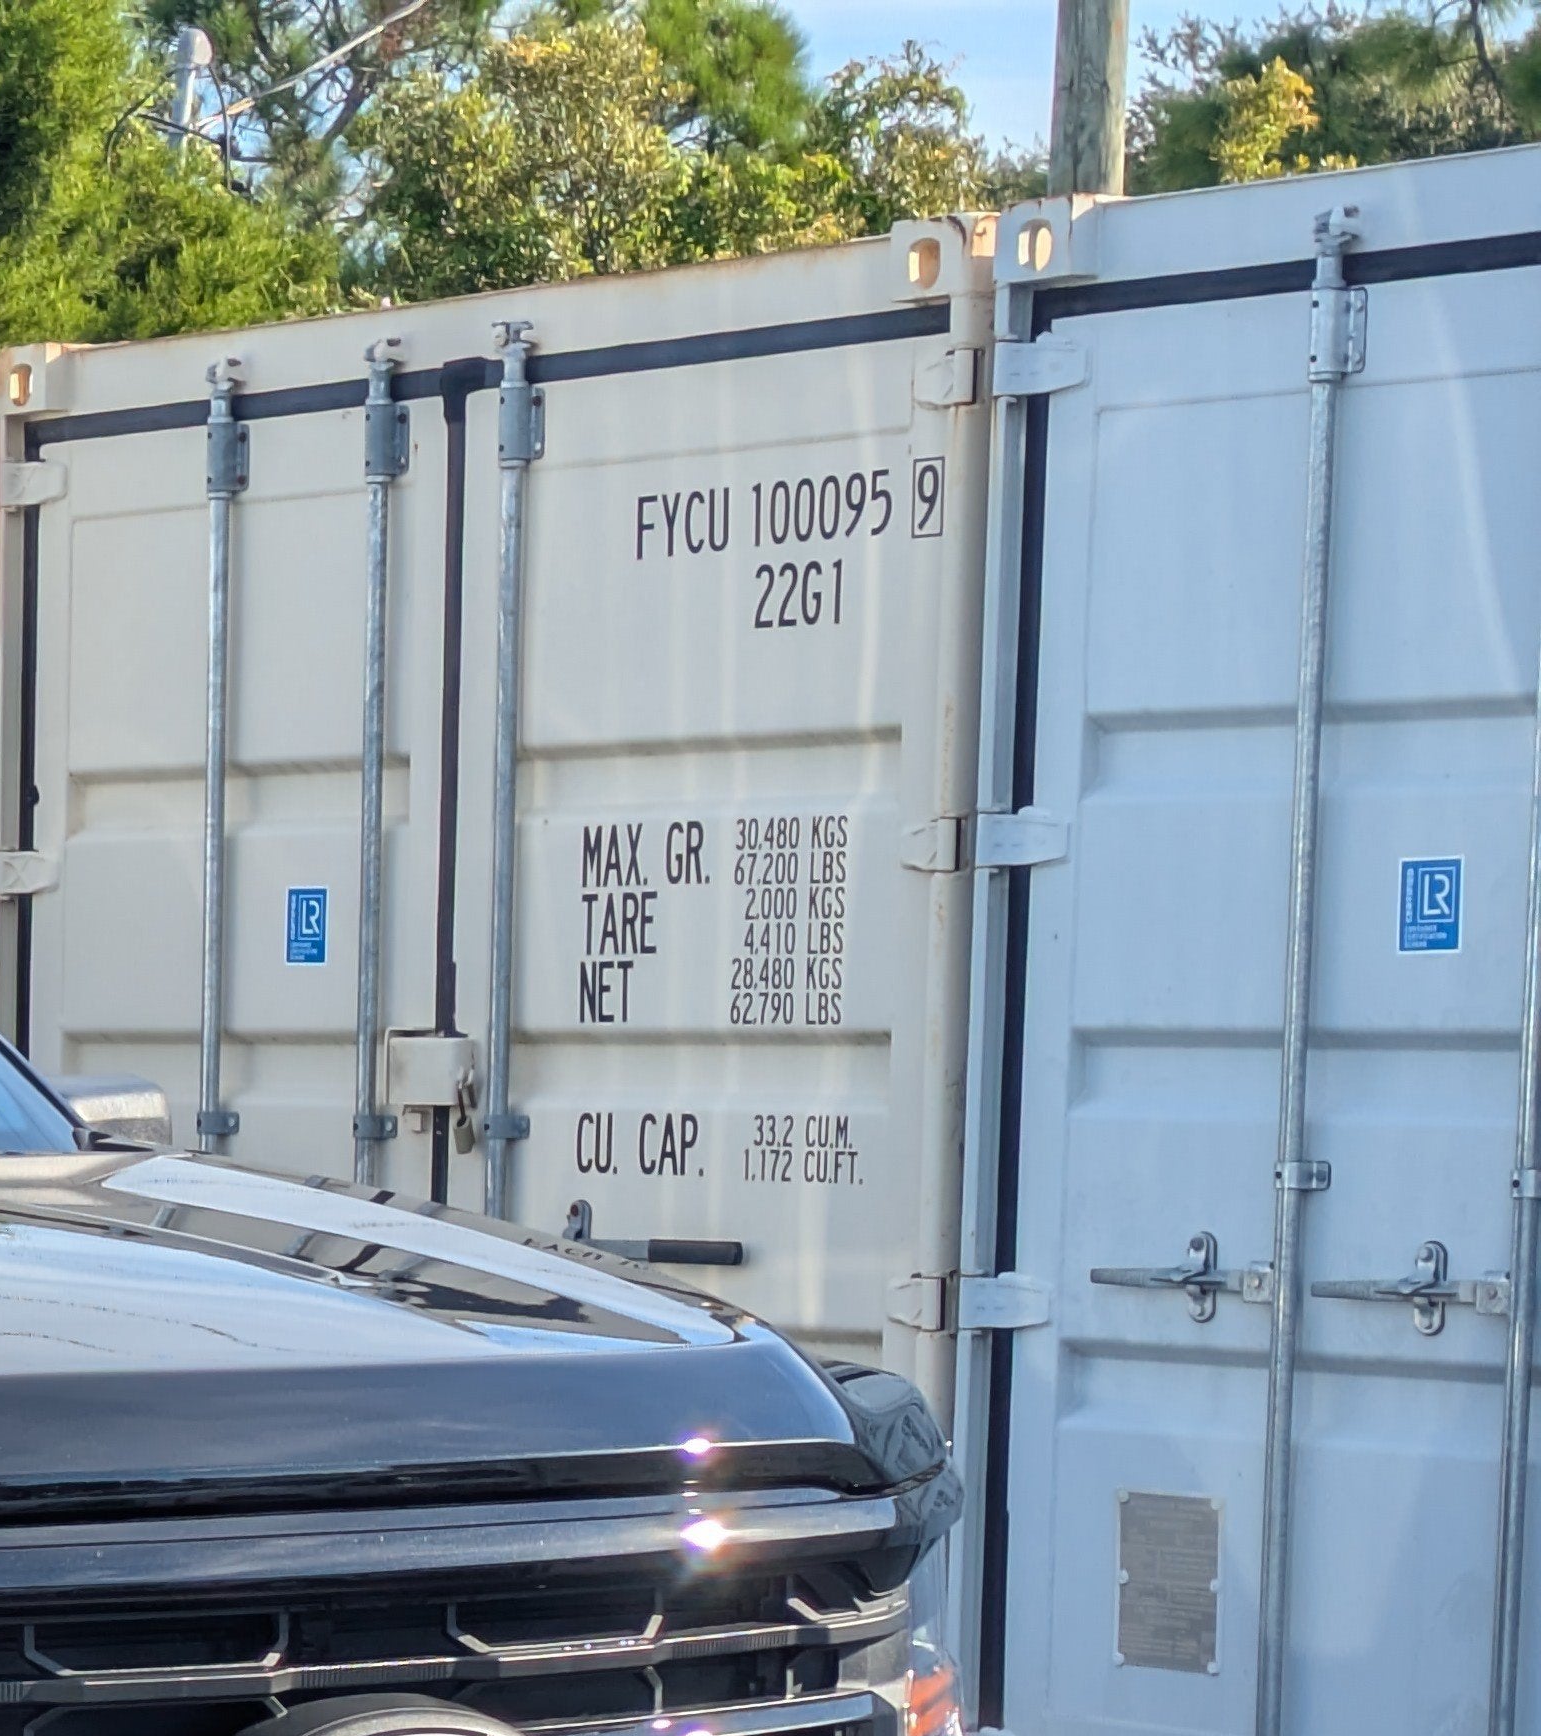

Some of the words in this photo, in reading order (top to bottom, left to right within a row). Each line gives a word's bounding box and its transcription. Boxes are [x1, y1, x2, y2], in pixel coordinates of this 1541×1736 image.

[636, 487, 731, 560] FYCU
[751, 468, 892, 547] 100095
[917, 463, 940, 531] 9
[754, 559, 843, 628] 22G1
[811, 815, 848, 849] KGS
[582, 822, 648, 888] MAX.
[666, 820, 711, 885] GR.
[810, 850, 847, 884] LBS
[808, 886, 845, 920] KGS
[581, 890, 658, 955] TARE
[807, 921, 844, 955] LBS
[805, 956, 843, 990] KGS
[579, 960, 634, 1023] NET
[805, 992, 842, 1025] LBS
[576, 1112, 618, 1175] CU.
[639, 1112, 704, 1177] CAP.
[753, 1114, 794, 1148] 33.2
